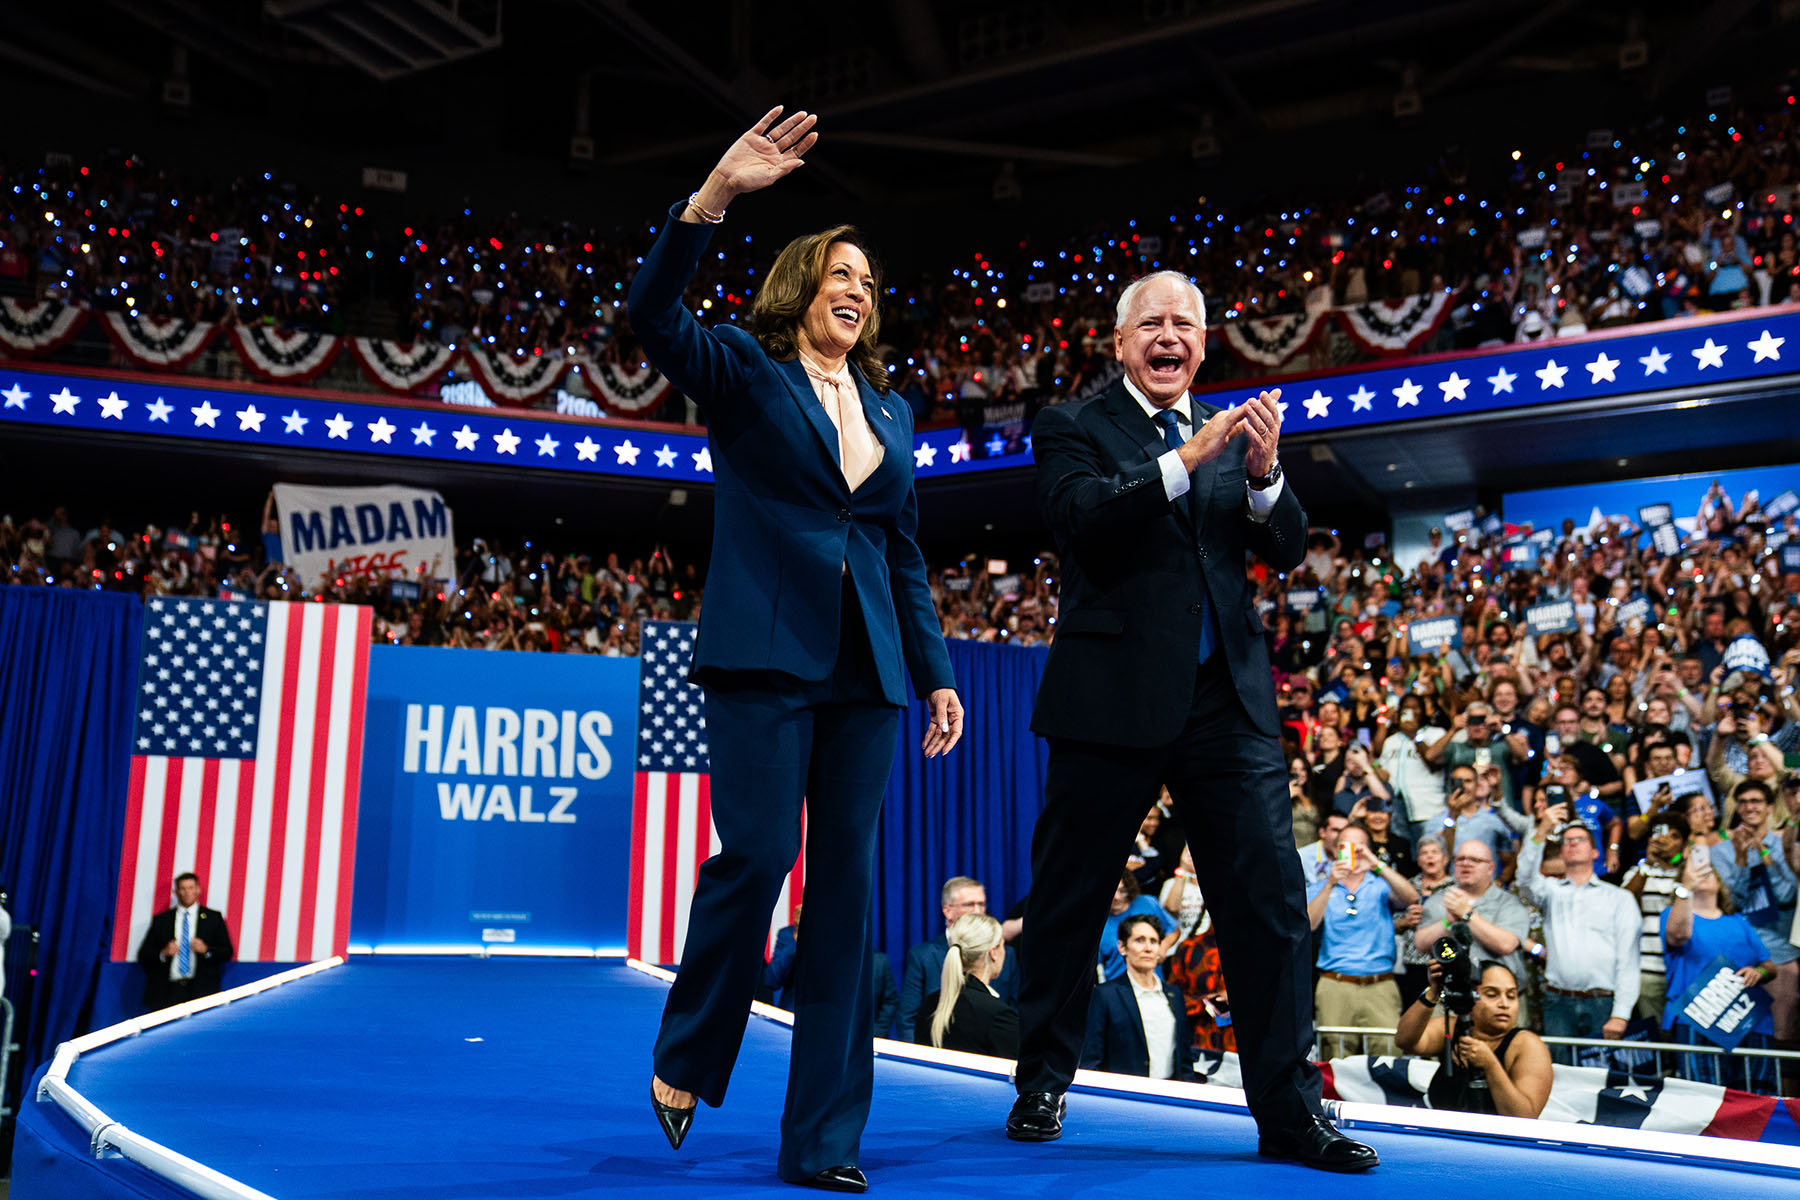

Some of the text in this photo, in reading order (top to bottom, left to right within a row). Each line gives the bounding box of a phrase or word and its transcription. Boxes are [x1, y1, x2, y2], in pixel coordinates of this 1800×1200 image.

[290, 498, 448, 554] MADAM
[1411, 619, 1458, 642] HARRIS
[1527, 602, 1573, 624] HARRIS
[404, 704, 613, 780] HARRIS
[437, 783, 578, 823] WALZ
[1683, 966, 1746, 1029] HARRIS
[1715, 993, 1756, 1033] WALZ
